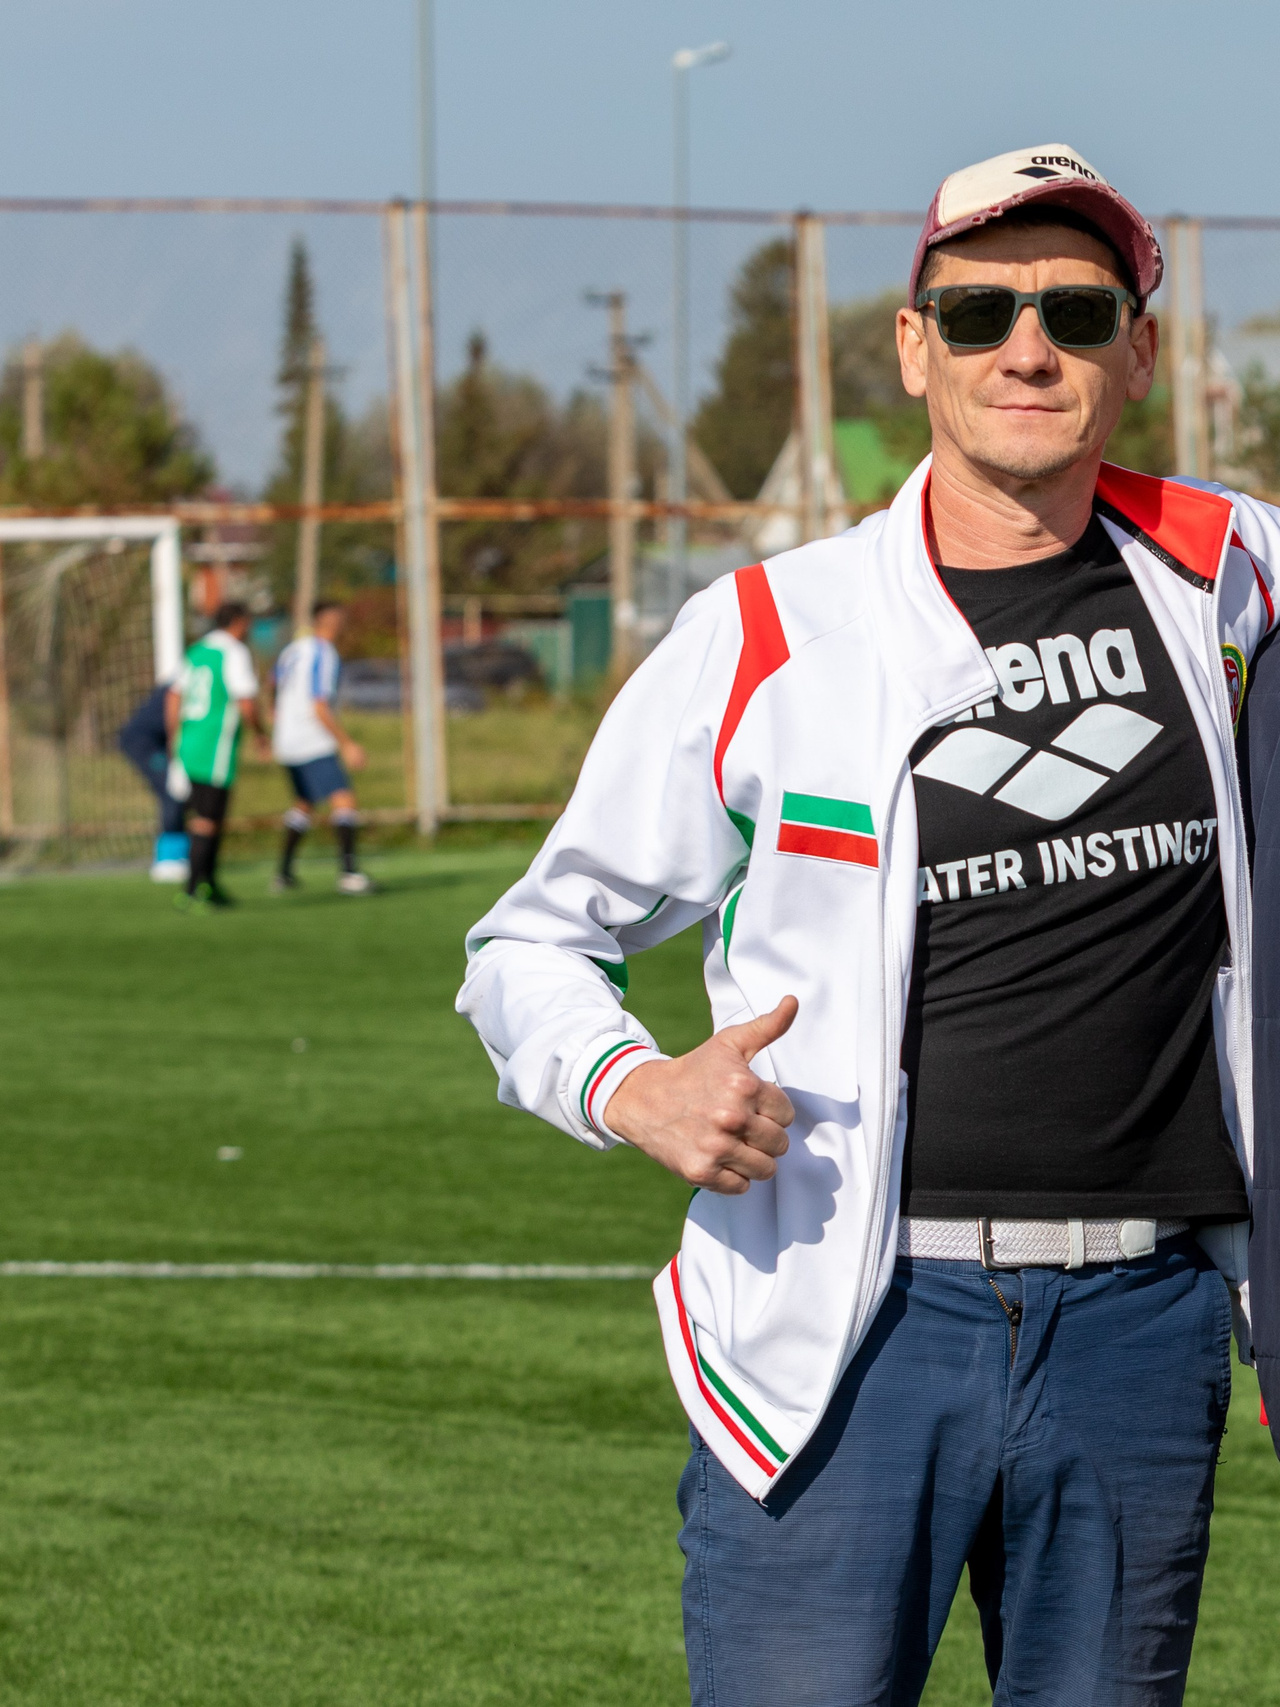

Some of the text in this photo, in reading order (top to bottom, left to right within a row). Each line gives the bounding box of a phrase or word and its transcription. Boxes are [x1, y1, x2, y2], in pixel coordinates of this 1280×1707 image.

[934, 628, 1147, 727] ena
[919, 818, 1217, 907] ATER INSTINCT
